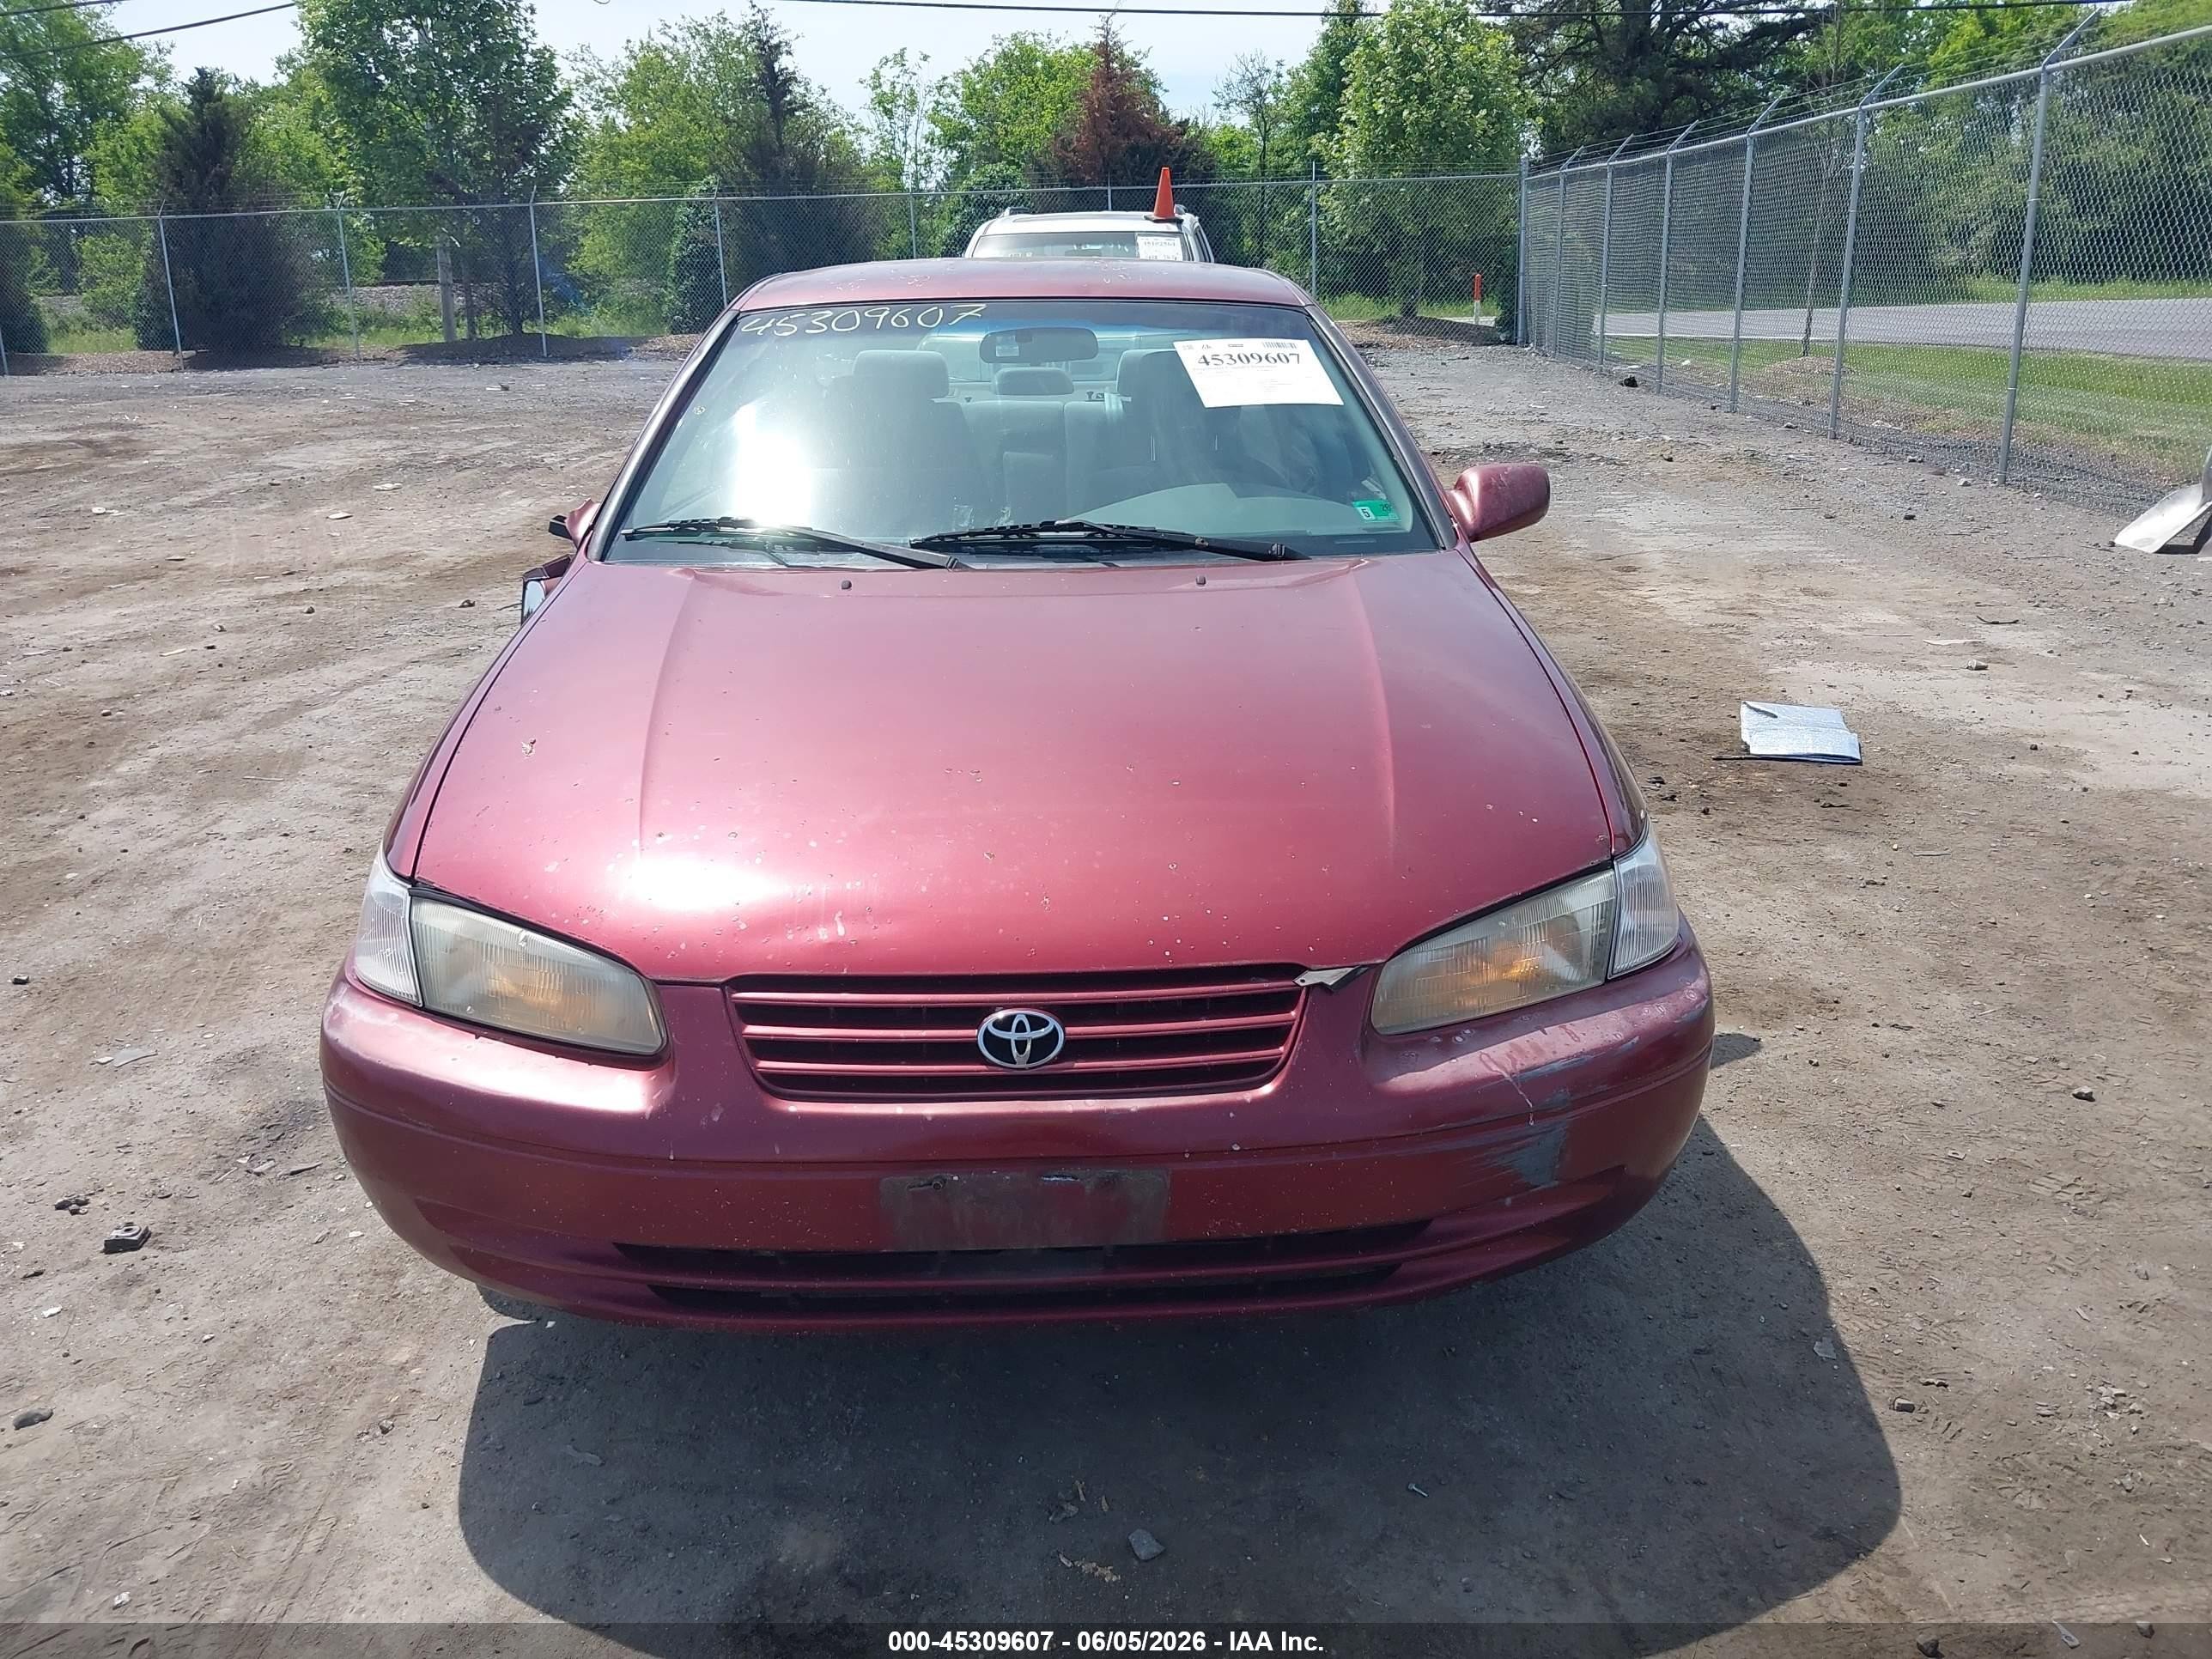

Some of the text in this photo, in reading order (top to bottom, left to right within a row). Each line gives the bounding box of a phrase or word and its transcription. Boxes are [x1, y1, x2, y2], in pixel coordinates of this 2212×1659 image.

[740, 303, 988, 337] 45309607
[1197, 352, 1301, 367] 45309607
[1361, 508, 1370, 518] 5
